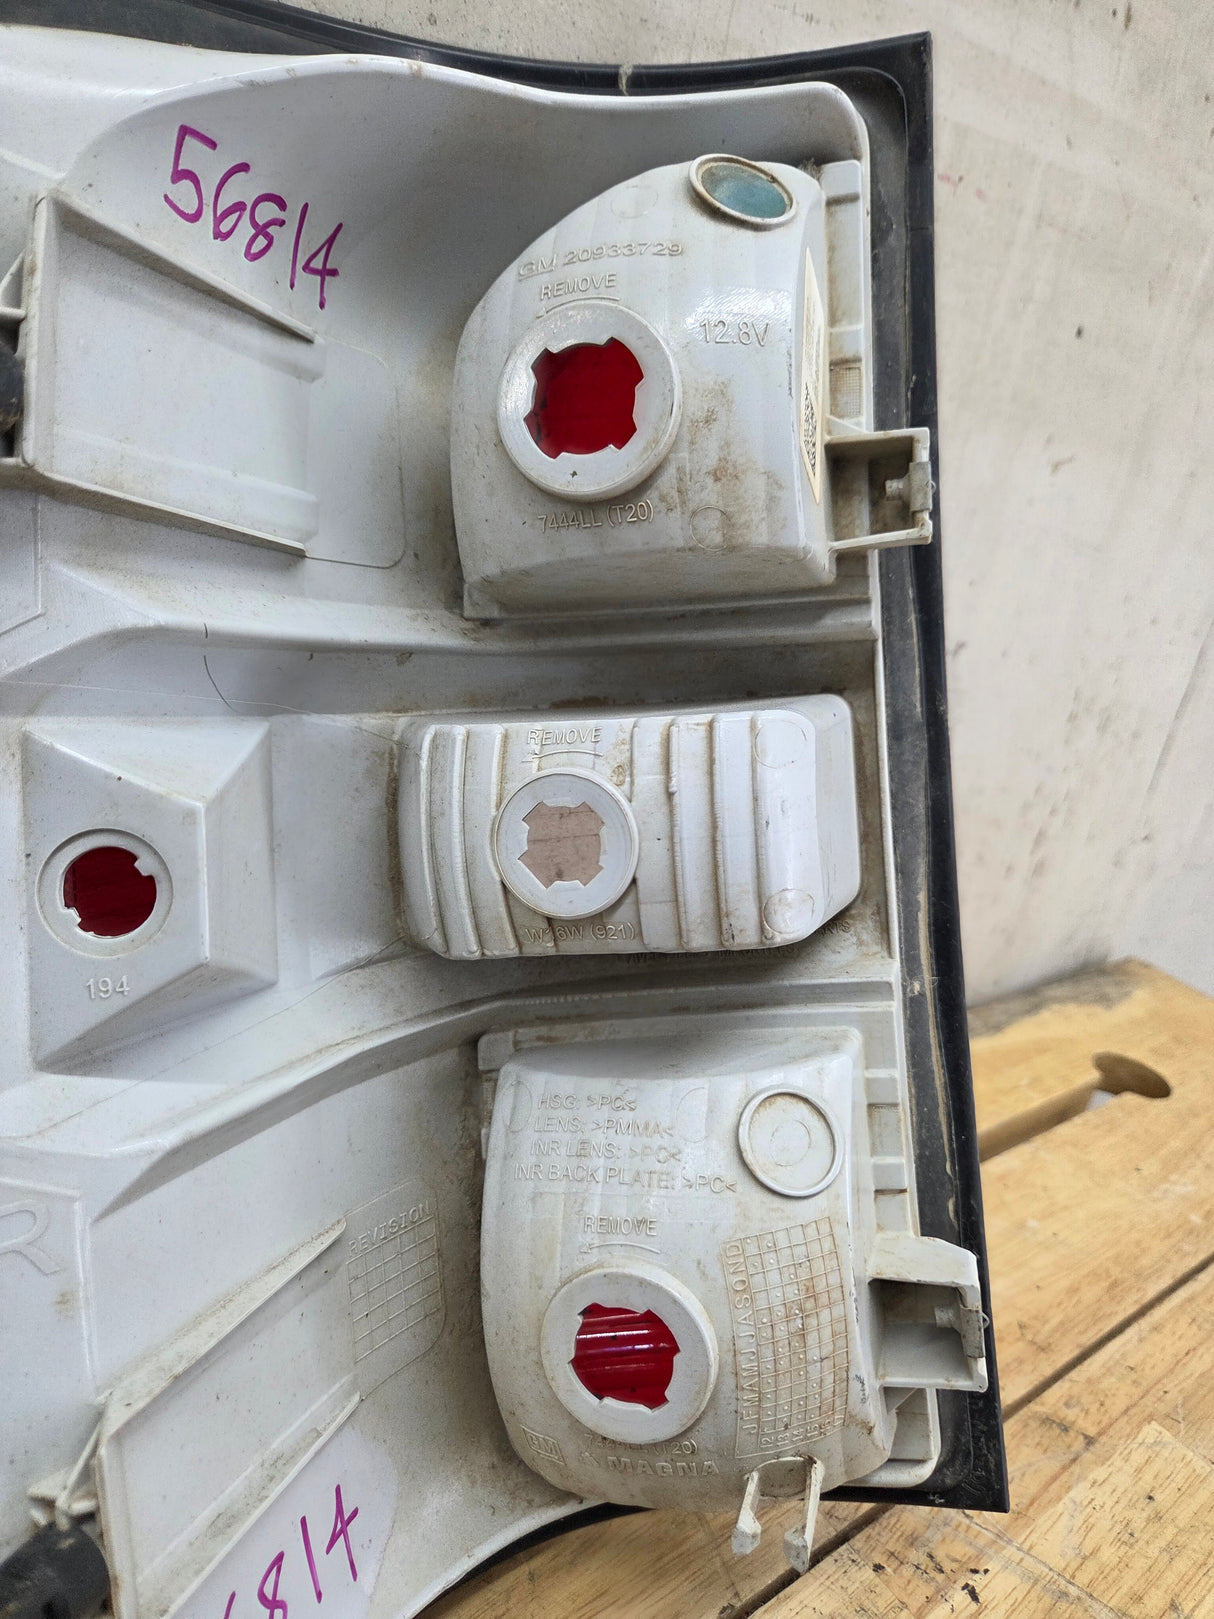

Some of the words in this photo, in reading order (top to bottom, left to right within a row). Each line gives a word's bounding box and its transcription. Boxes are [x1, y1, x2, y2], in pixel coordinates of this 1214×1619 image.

[163, 123, 343, 311] 56814
[518, 255, 556, 281] GM
[563, 240, 683, 266] 20933729
[540, 273, 618, 301] REMOVE
[699, 319, 769, 347] 12.8V
[537, 509, 602, 533] 7444LL
[606, 499, 654, 527] (T20)
[527, 726, 602, 746] REMOVE
[590, 922, 635, 941] (921)
[86, 974, 131, 1000] 194
[586, 1094, 637, 1112] >PC<
[591, 1117, 674, 1138] >PMMA<
[530, 1139, 562, 1157] INR
[566, 1140, 621, 1160] LENS:
[513, 1163, 545, 1181] INR
[549, 1164, 600, 1184] BACK
[605, 1167, 676, 1190] PLATE:
[681, 1171, 738, 1194] >PC<
[348, 1199, 431, 1257] REVISION
[584, 1215, 658, 1238] REMOVE
[605, 1456, 720, 1478] MAGNA
[223, 1483, 359, 1619] 814
